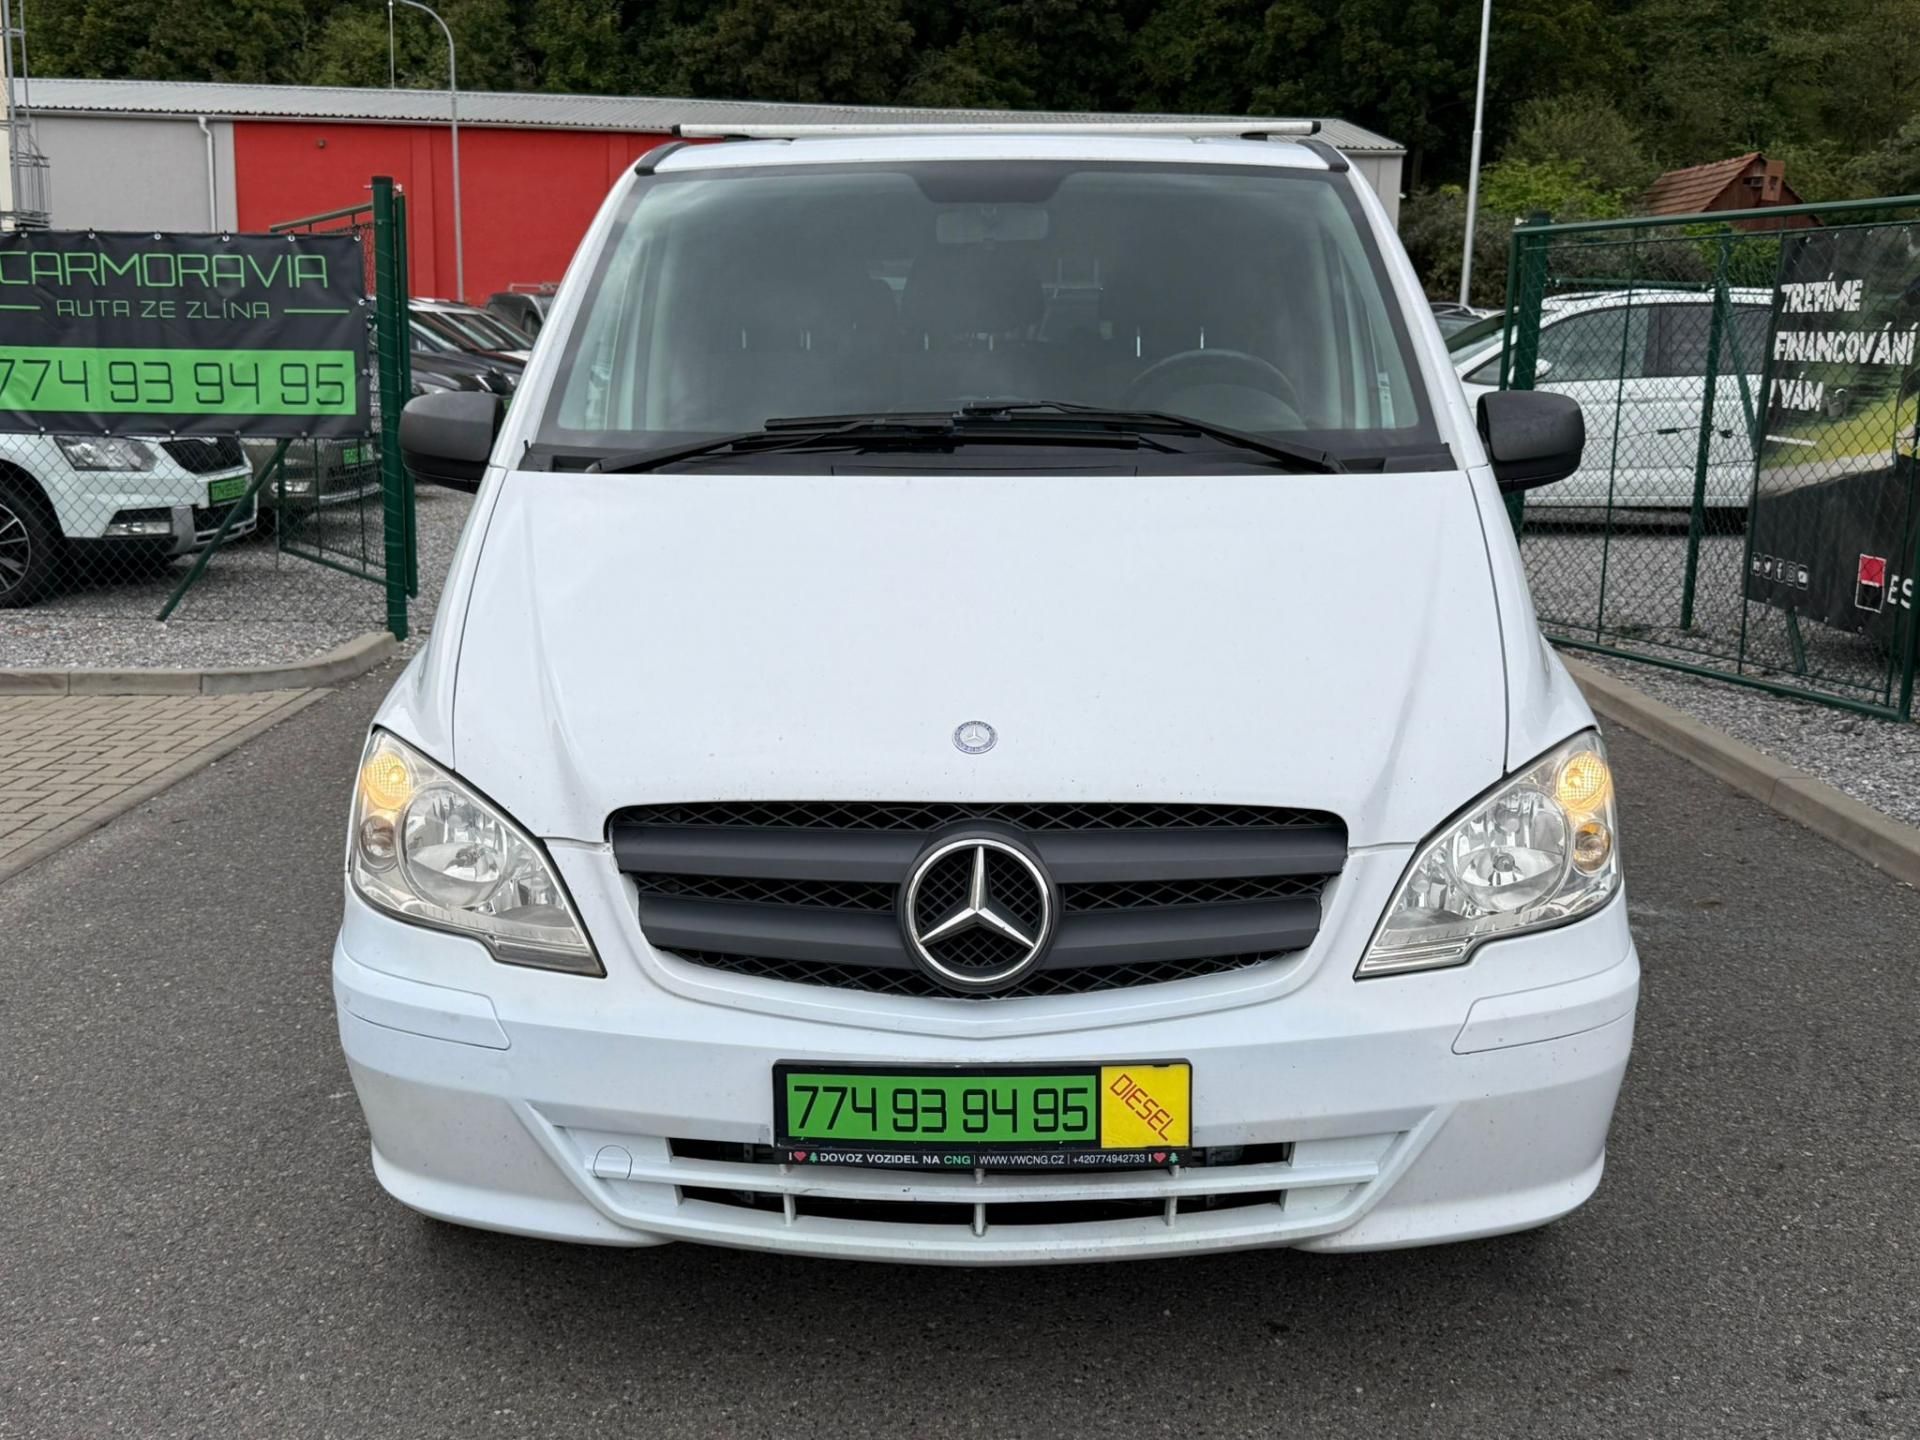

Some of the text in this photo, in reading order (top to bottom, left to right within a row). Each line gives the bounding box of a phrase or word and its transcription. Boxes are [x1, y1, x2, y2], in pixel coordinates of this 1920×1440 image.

[0, 251, 329, 289] CARMORAVIA
[56, 298, 270, 319] AUTA ZE ZLÍNA
[1773, 321, 1919, 365] FINANCOVÁNÍ
[109, 361, 174, 404] 93
[194, 362, 260, 405] 94
[280, 363, 345, 406] 95
[1778, 371, 1825, 412] VÁM
[793, 1085, 1088, 1134] 774 93 94 95
[1109, 1073, 1174, 1142] DIESEL
[819, 1152, 864, 1163] DOVOZ
[867, 1153, 918, 1164] VOZIDEL
[922, 1154, 941, 1165] NA
[943, 1155, 971, 1165] CNG
[979, 1154, 1065, 1165] WWW.VWCNG.CZ
[1072, 1153, 1146, 1164] +420774942733
